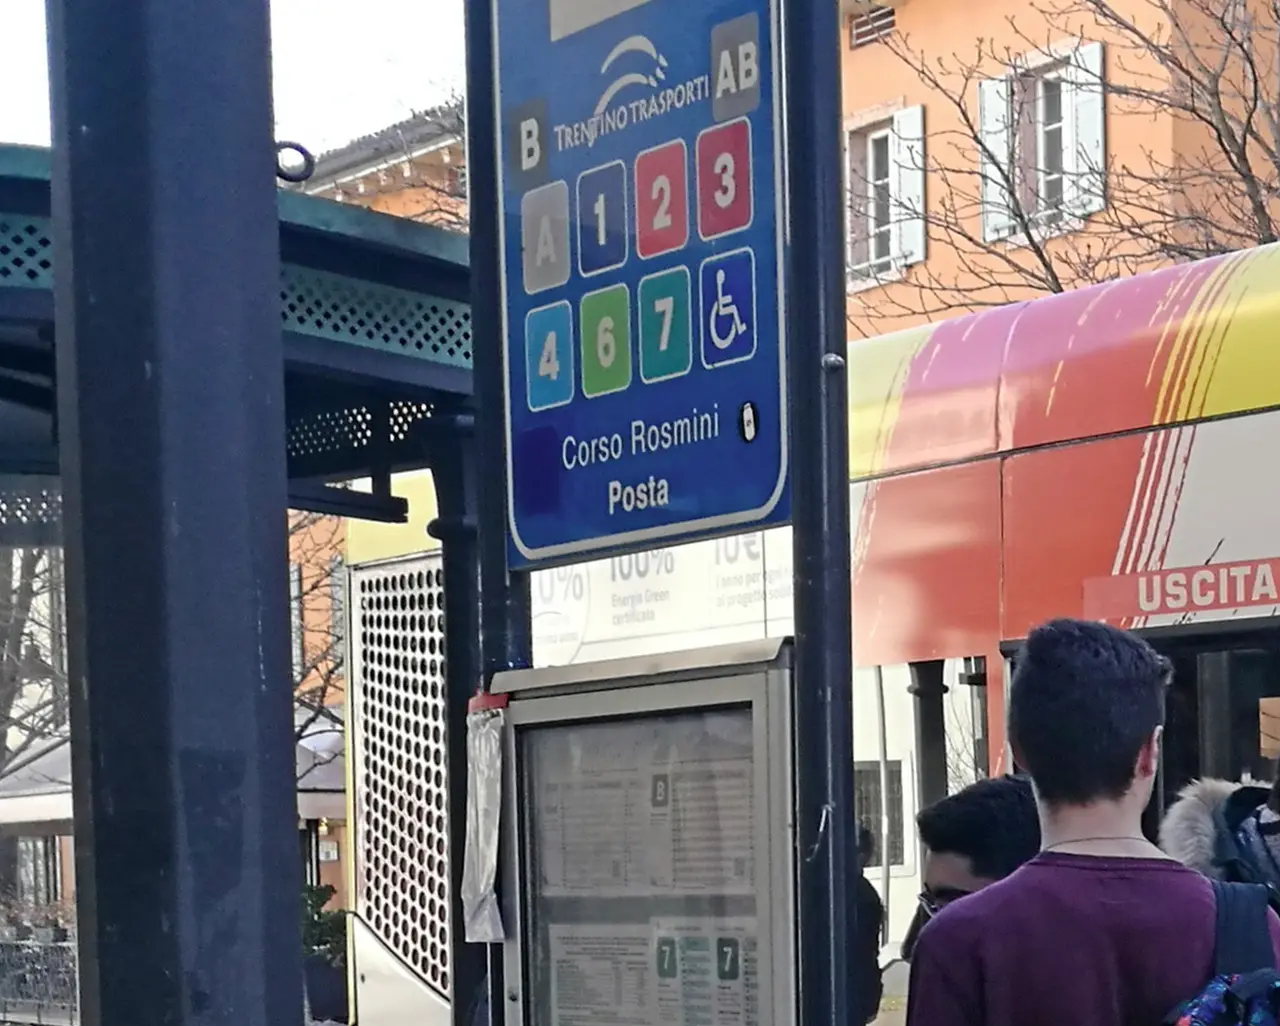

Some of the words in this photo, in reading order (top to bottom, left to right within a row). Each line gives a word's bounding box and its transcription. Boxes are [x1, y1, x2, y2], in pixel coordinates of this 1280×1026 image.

[716, 40, 758, 98] AB
[628, 75, 710, 124] TRASPORTI
[520, 117, 541, 171] B
[535, 214, 556, 267] A
[594, 192, 607, 246] 1
[652, 175, 672, 230] 2
[714, 152, 735, 209] 3
[538, 330, 560, 381] 4
[596, 316, 615, 368] 6
[655, 297, 674, 352] 7
[562, 425, 622, 470] Corso
[630, 403, 720, 457] Rosmini
[607, 478, 669, 515] Posta
[1138, 563, 1278, 612] USCITA
